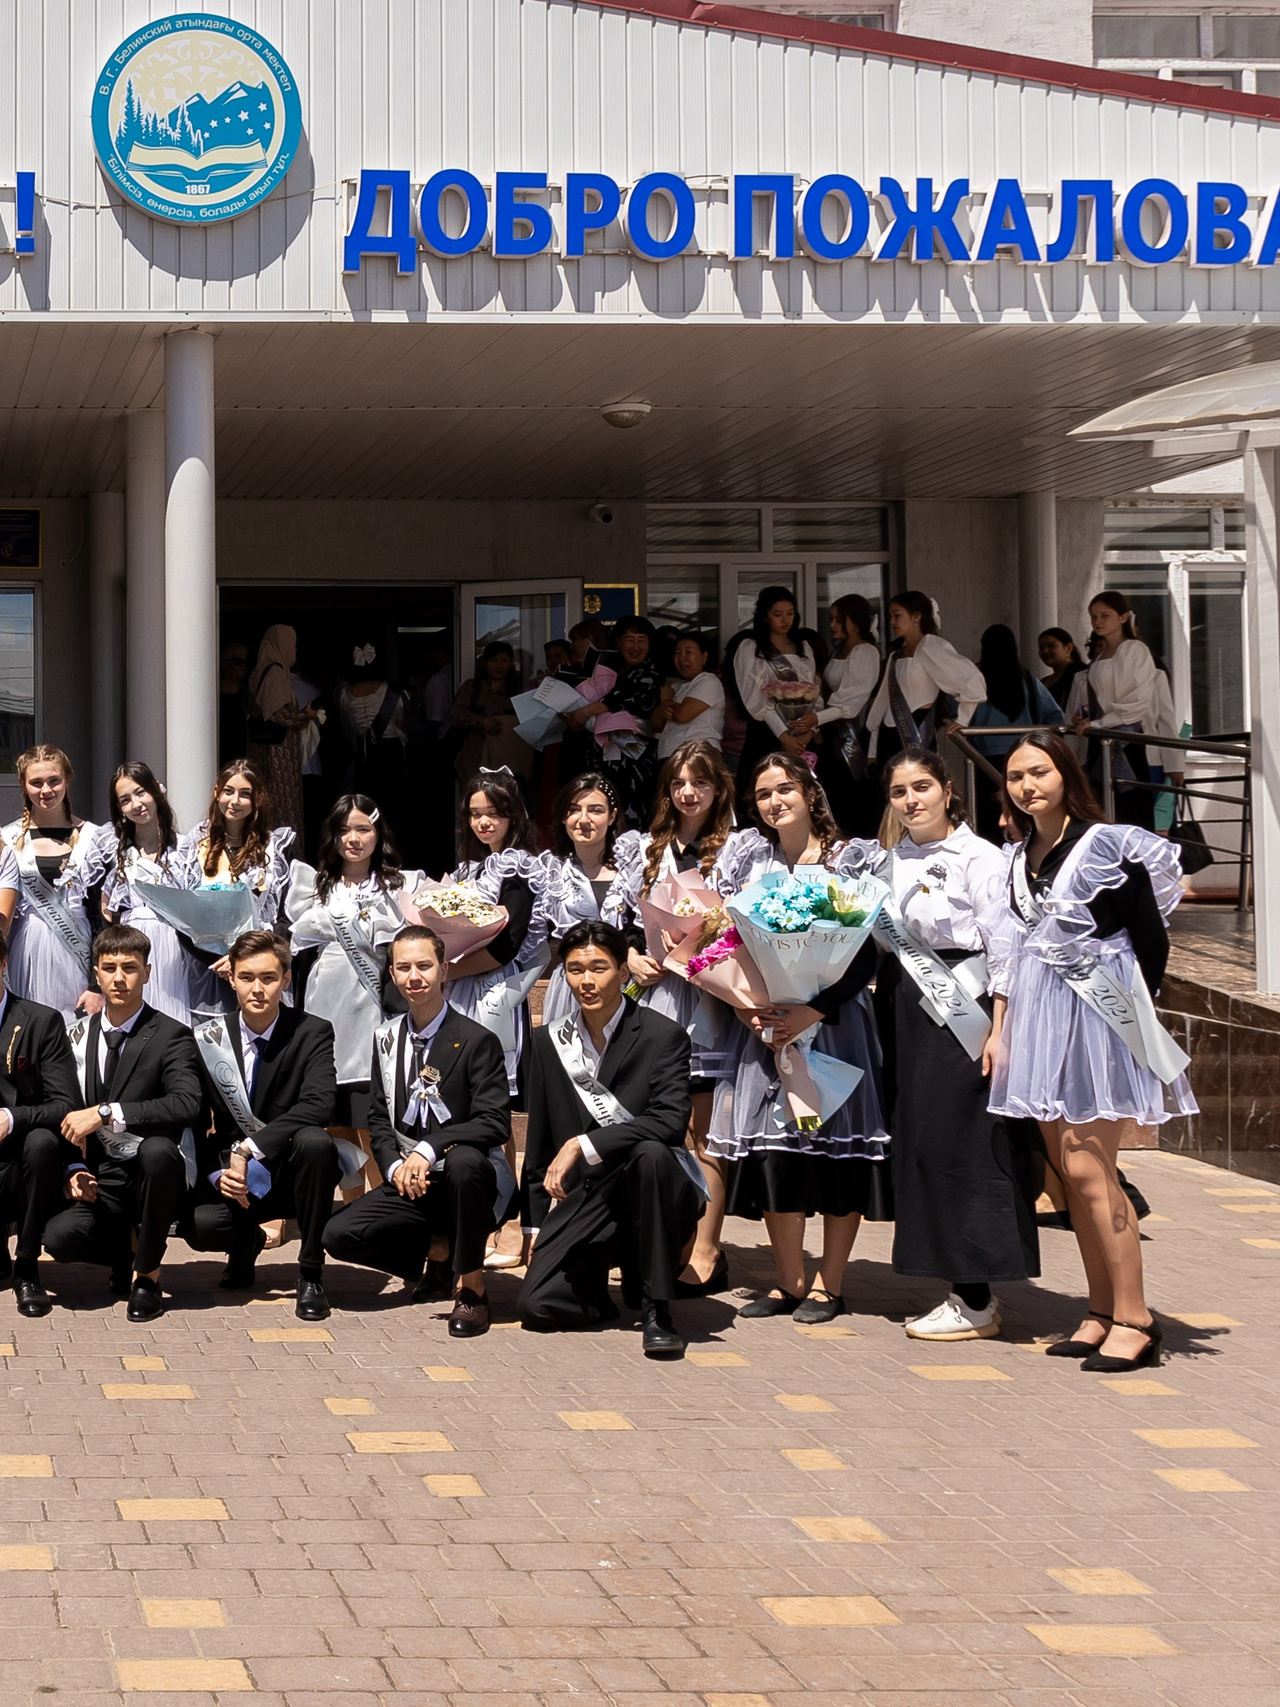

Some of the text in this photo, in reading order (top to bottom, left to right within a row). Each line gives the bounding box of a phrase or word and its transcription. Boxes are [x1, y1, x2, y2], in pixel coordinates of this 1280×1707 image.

[114, 20, 172, 65] Белинский
[175, 19, 235, 33] атындағы
[236, 29, 263, 49] орта
[262, 48, 292, 92] мектеп
[185, 184, 211, 195] 1867
[200, 198, 247, 218] болады
[248, 175, 274, 201] ақыл
[343, 169, 696, 274] ДОБРО
[1088, 984, 1135, 1025] 2024
